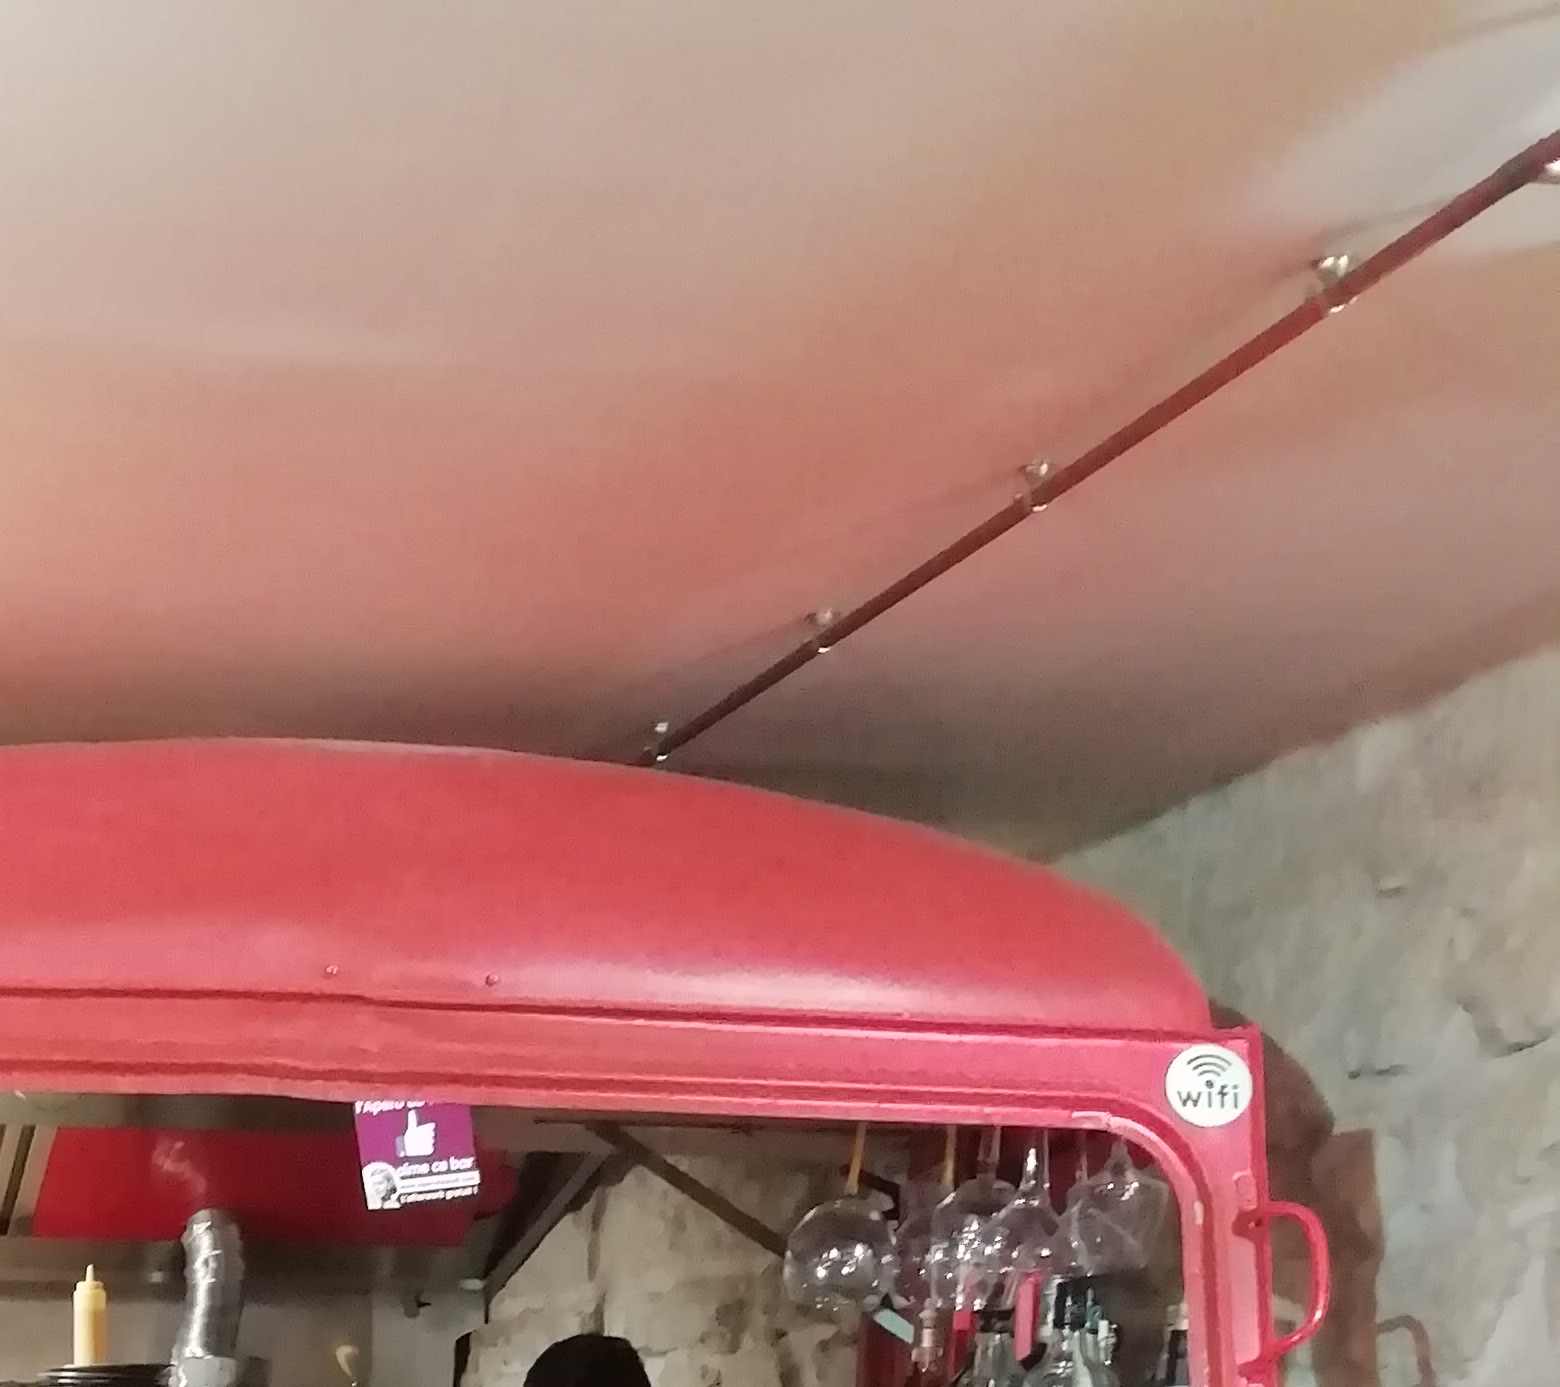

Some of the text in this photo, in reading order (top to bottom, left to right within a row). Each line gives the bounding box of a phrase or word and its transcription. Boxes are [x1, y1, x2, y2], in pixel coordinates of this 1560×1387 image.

[1176, 1080, 1240, 1109] wifi
[431, 1160, 448, 1173] ce
[449, 1156, 475, 1171] bar
